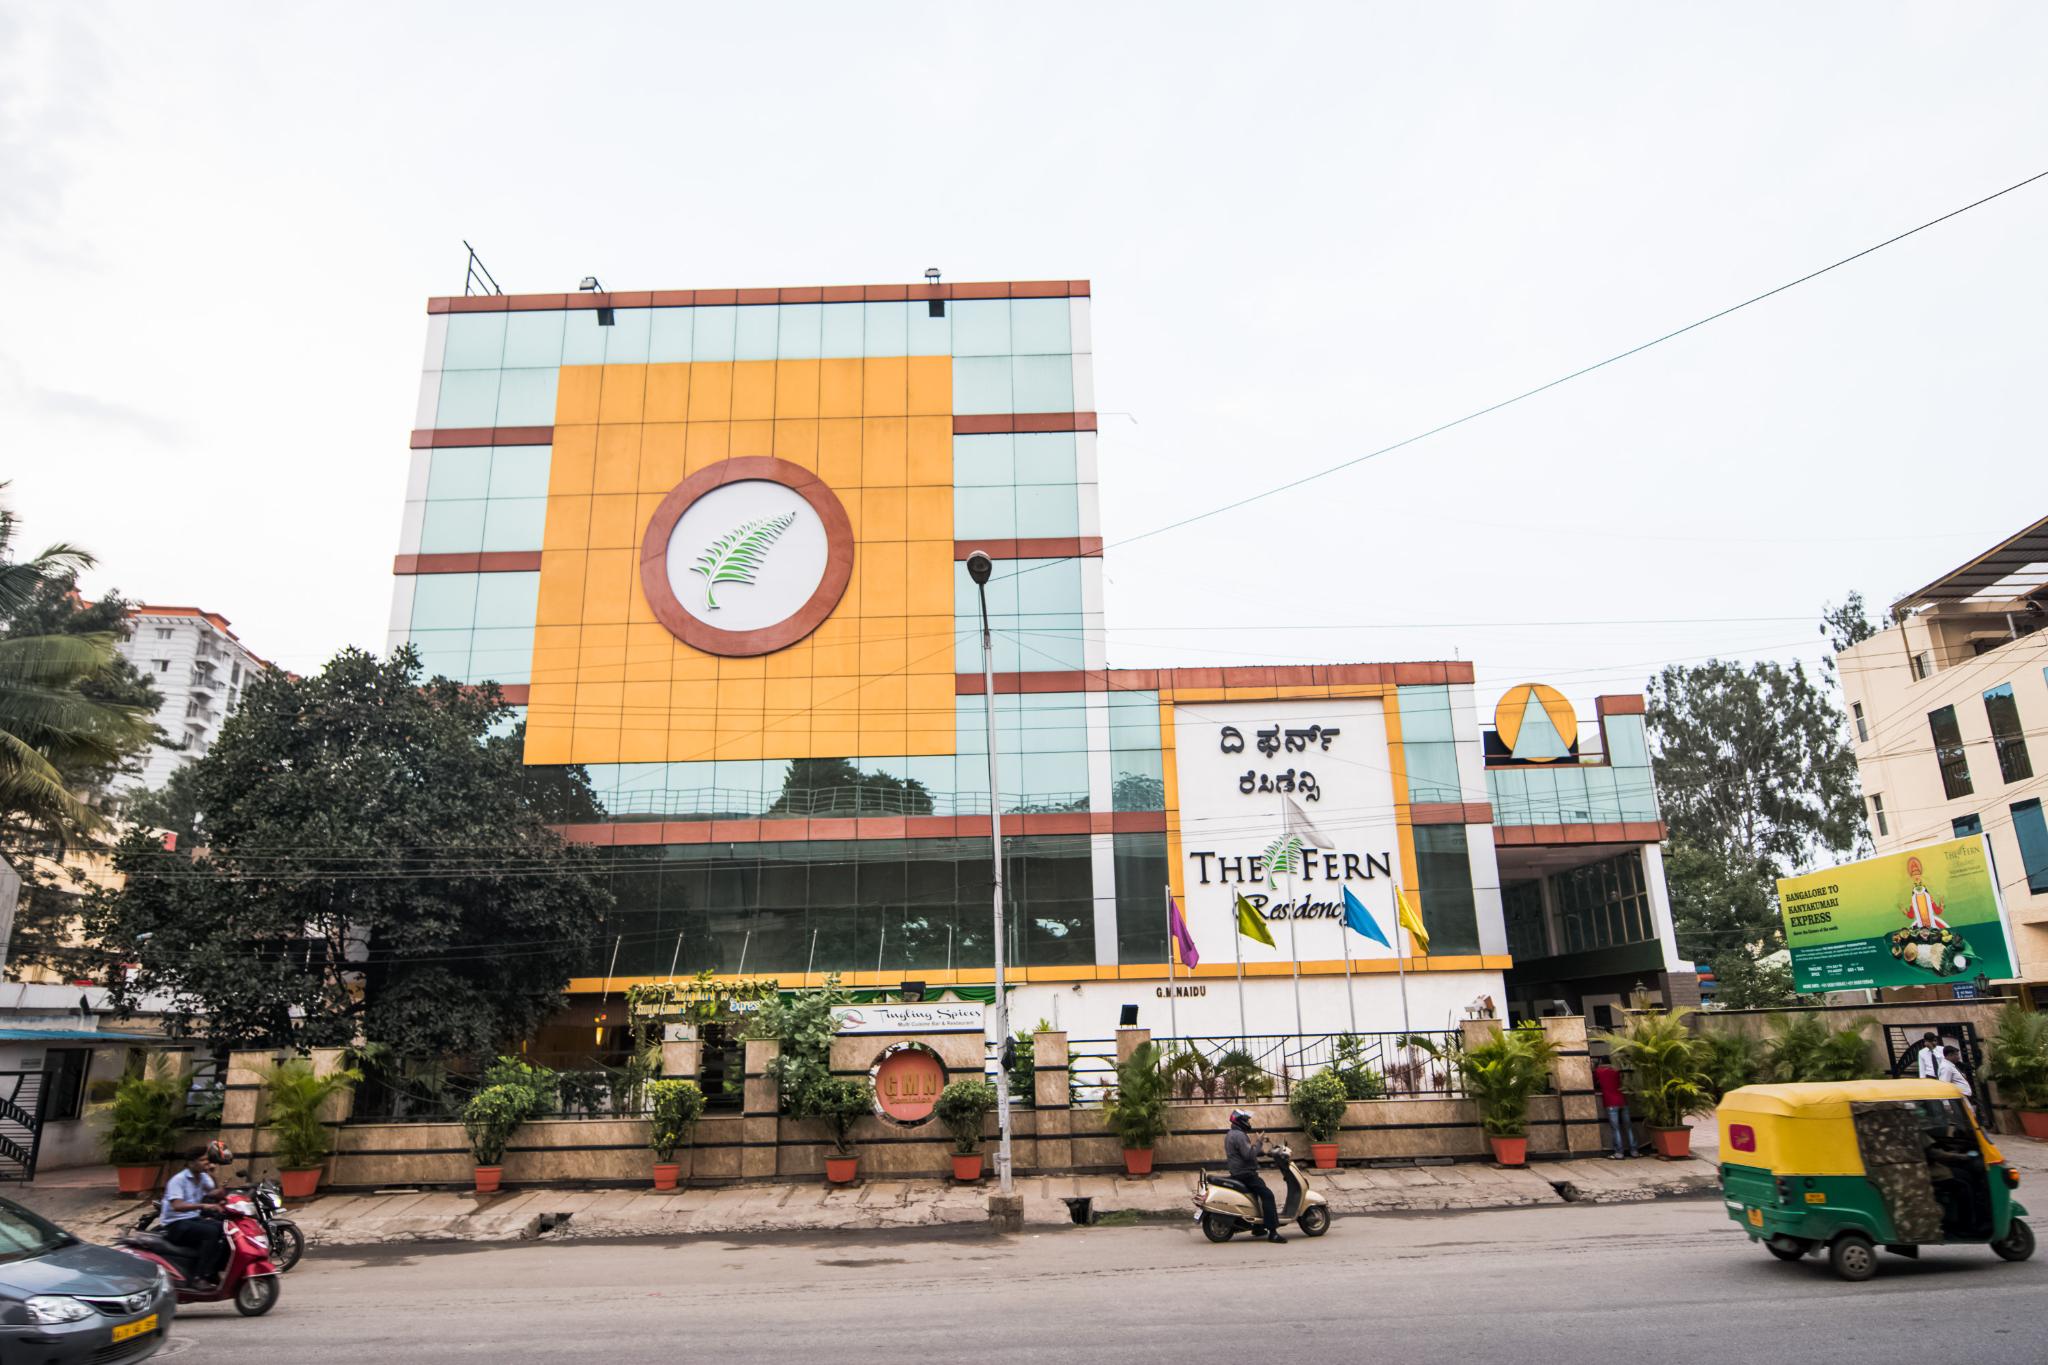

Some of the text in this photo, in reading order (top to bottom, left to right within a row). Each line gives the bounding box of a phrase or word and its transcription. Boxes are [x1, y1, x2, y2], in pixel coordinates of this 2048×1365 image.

[1221, 726, 1244, 754] ದಿ
[1190, 848, 1391, 884] THE FERN
[1785, 884, 1839, 902] BANGALORE TO
[1788, 898, 1839, 914] KANYAKUMARI
[1790, 911, 1832, 927] EXPRESS
[872, 1008, 981, 1023] Tingling Spices
